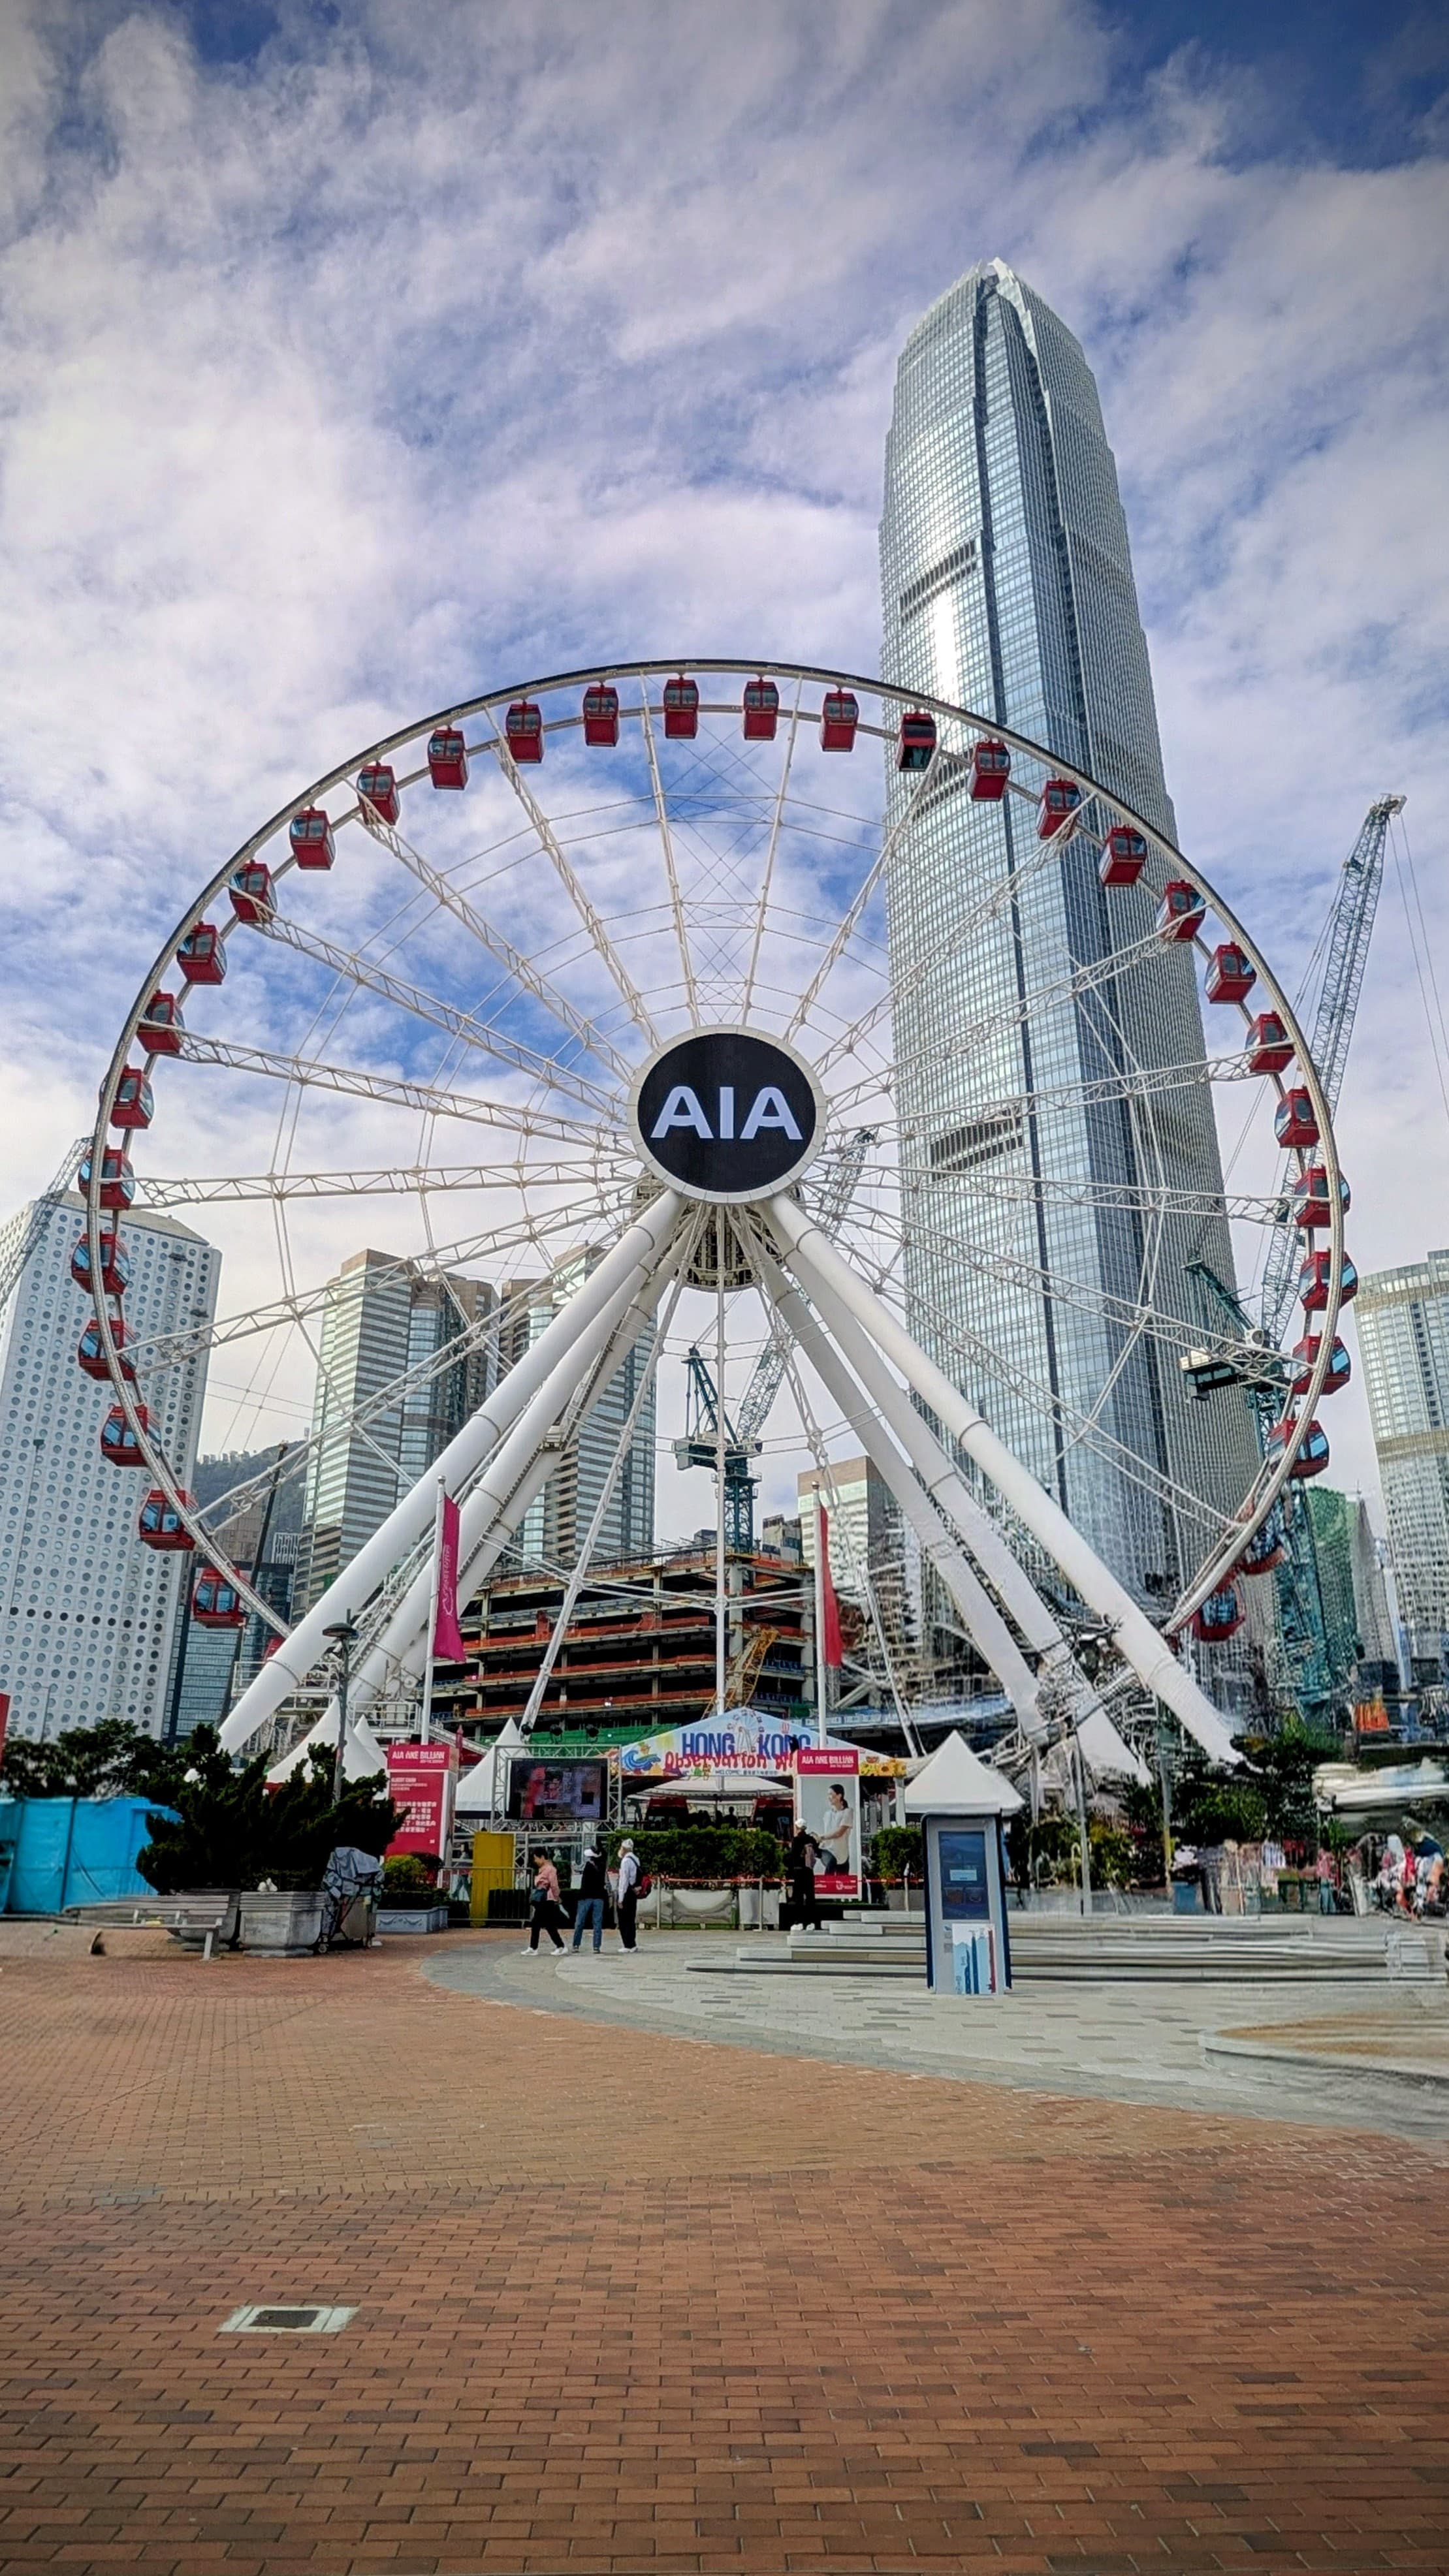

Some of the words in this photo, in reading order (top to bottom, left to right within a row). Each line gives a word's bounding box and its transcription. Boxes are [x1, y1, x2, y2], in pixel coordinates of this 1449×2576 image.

[650, 1086, 804, 1140] AIA
[682, 1732, 735, 1759] HONG
[801, 1755, 814, 1765] AIA
